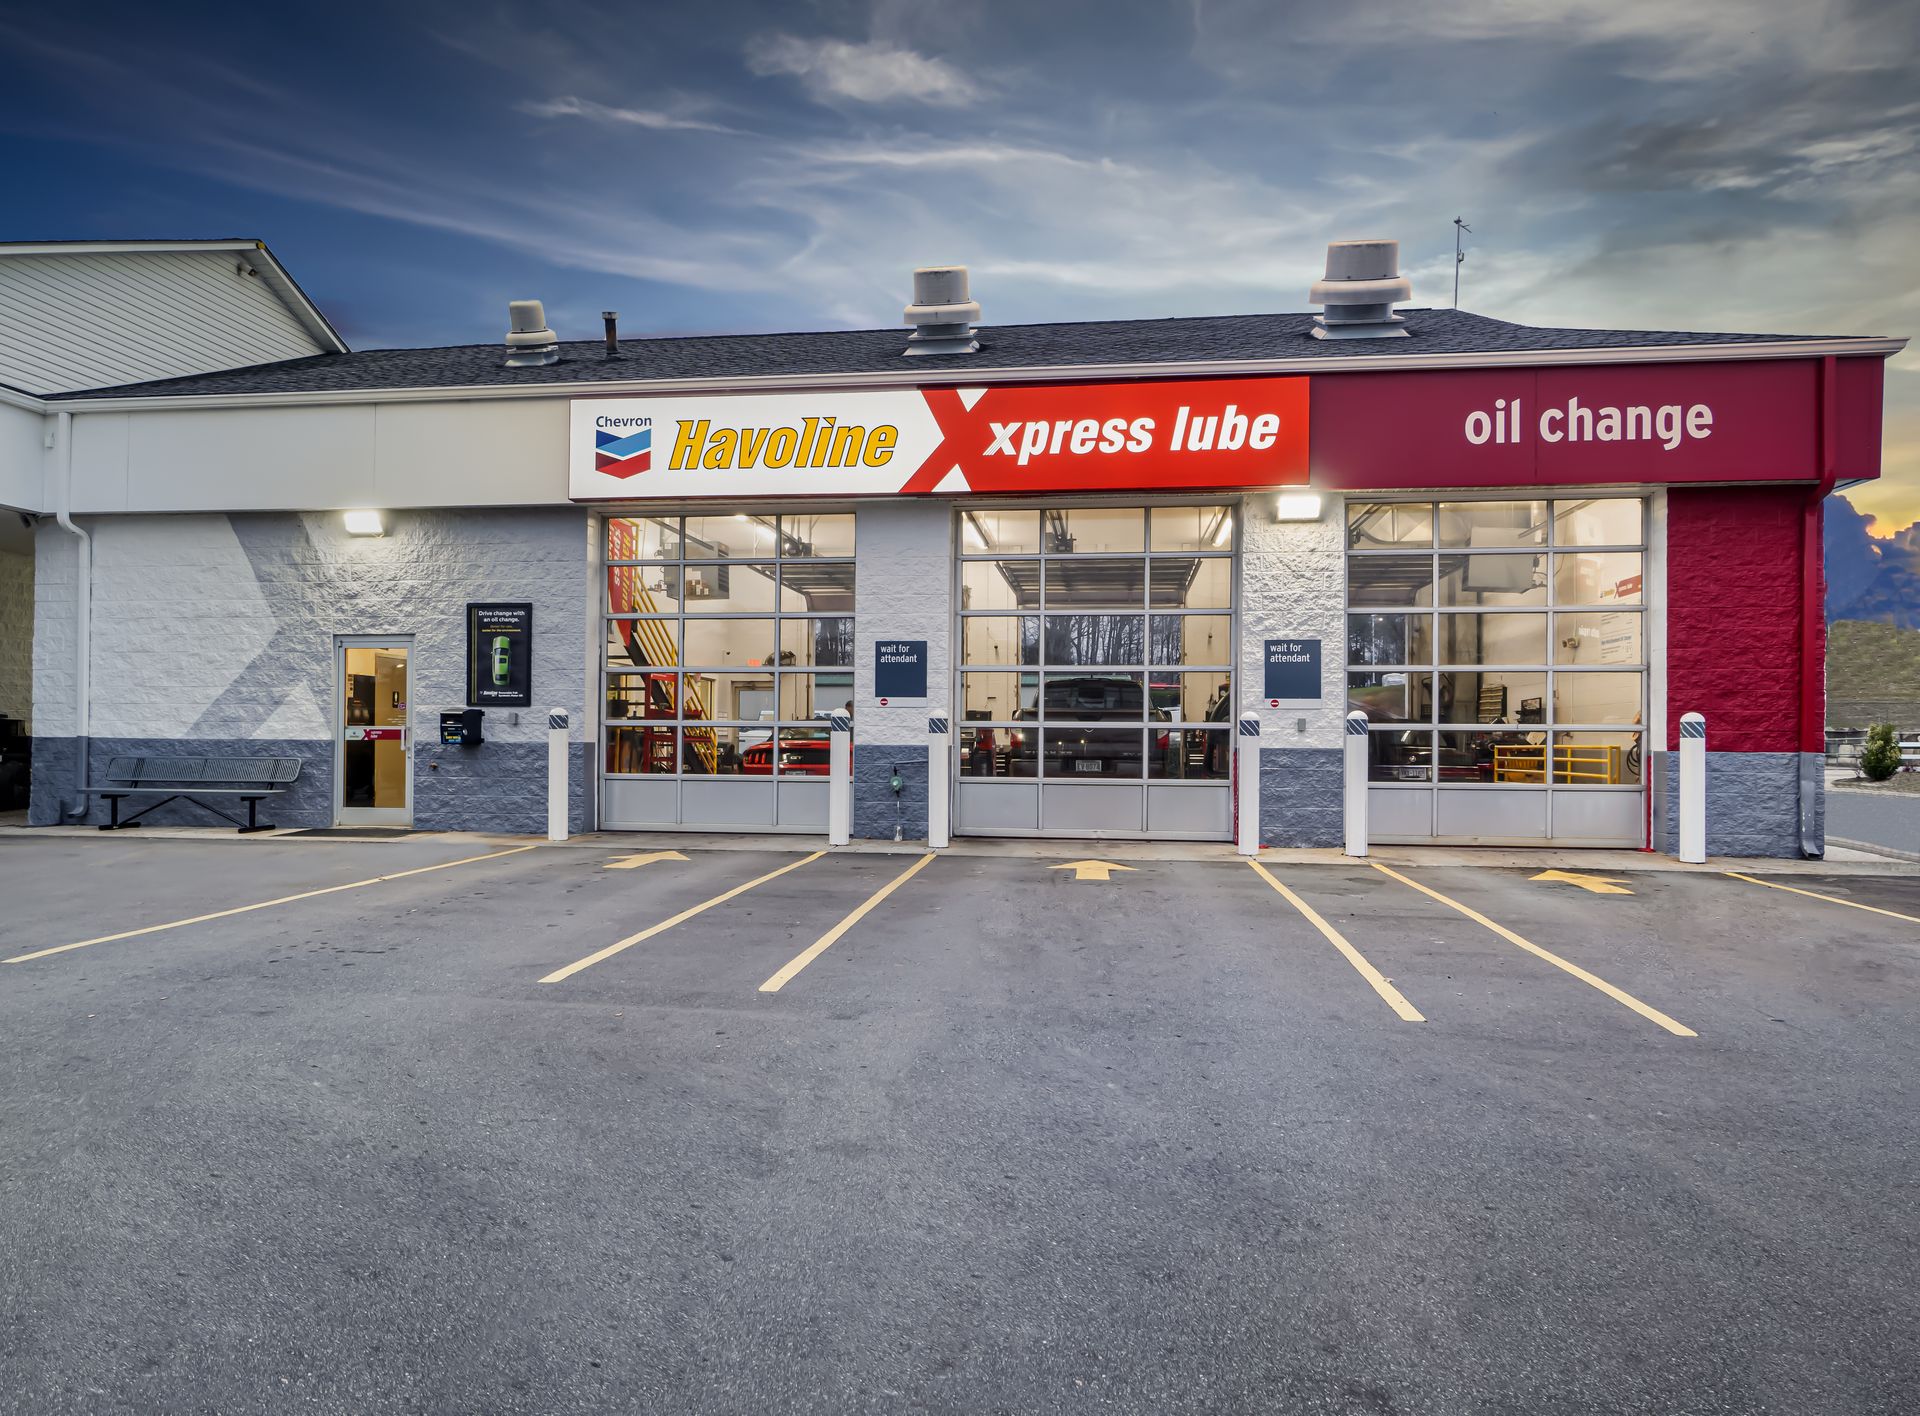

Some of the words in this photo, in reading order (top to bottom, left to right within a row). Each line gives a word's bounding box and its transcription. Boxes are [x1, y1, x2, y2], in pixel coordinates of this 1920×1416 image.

[595, 415, 652, 428] Chevron
[1464, 398, 1521, 445] oil
[1539, 396, 1713, 451] change
[668, 416, 899, 471] Havoline
[982, 417, 1155, 466] xpress
[1169, 404, 1281, 452] lube
[880, 644, 897, 653] wait
[898, 644, 910, 653] for
[1270, 643, 1288, 652] wait
[1289, 643, 1302, 652] for
[880, 654, 918, 663] attendant
[1270, 653, 1310, 663] attendant
